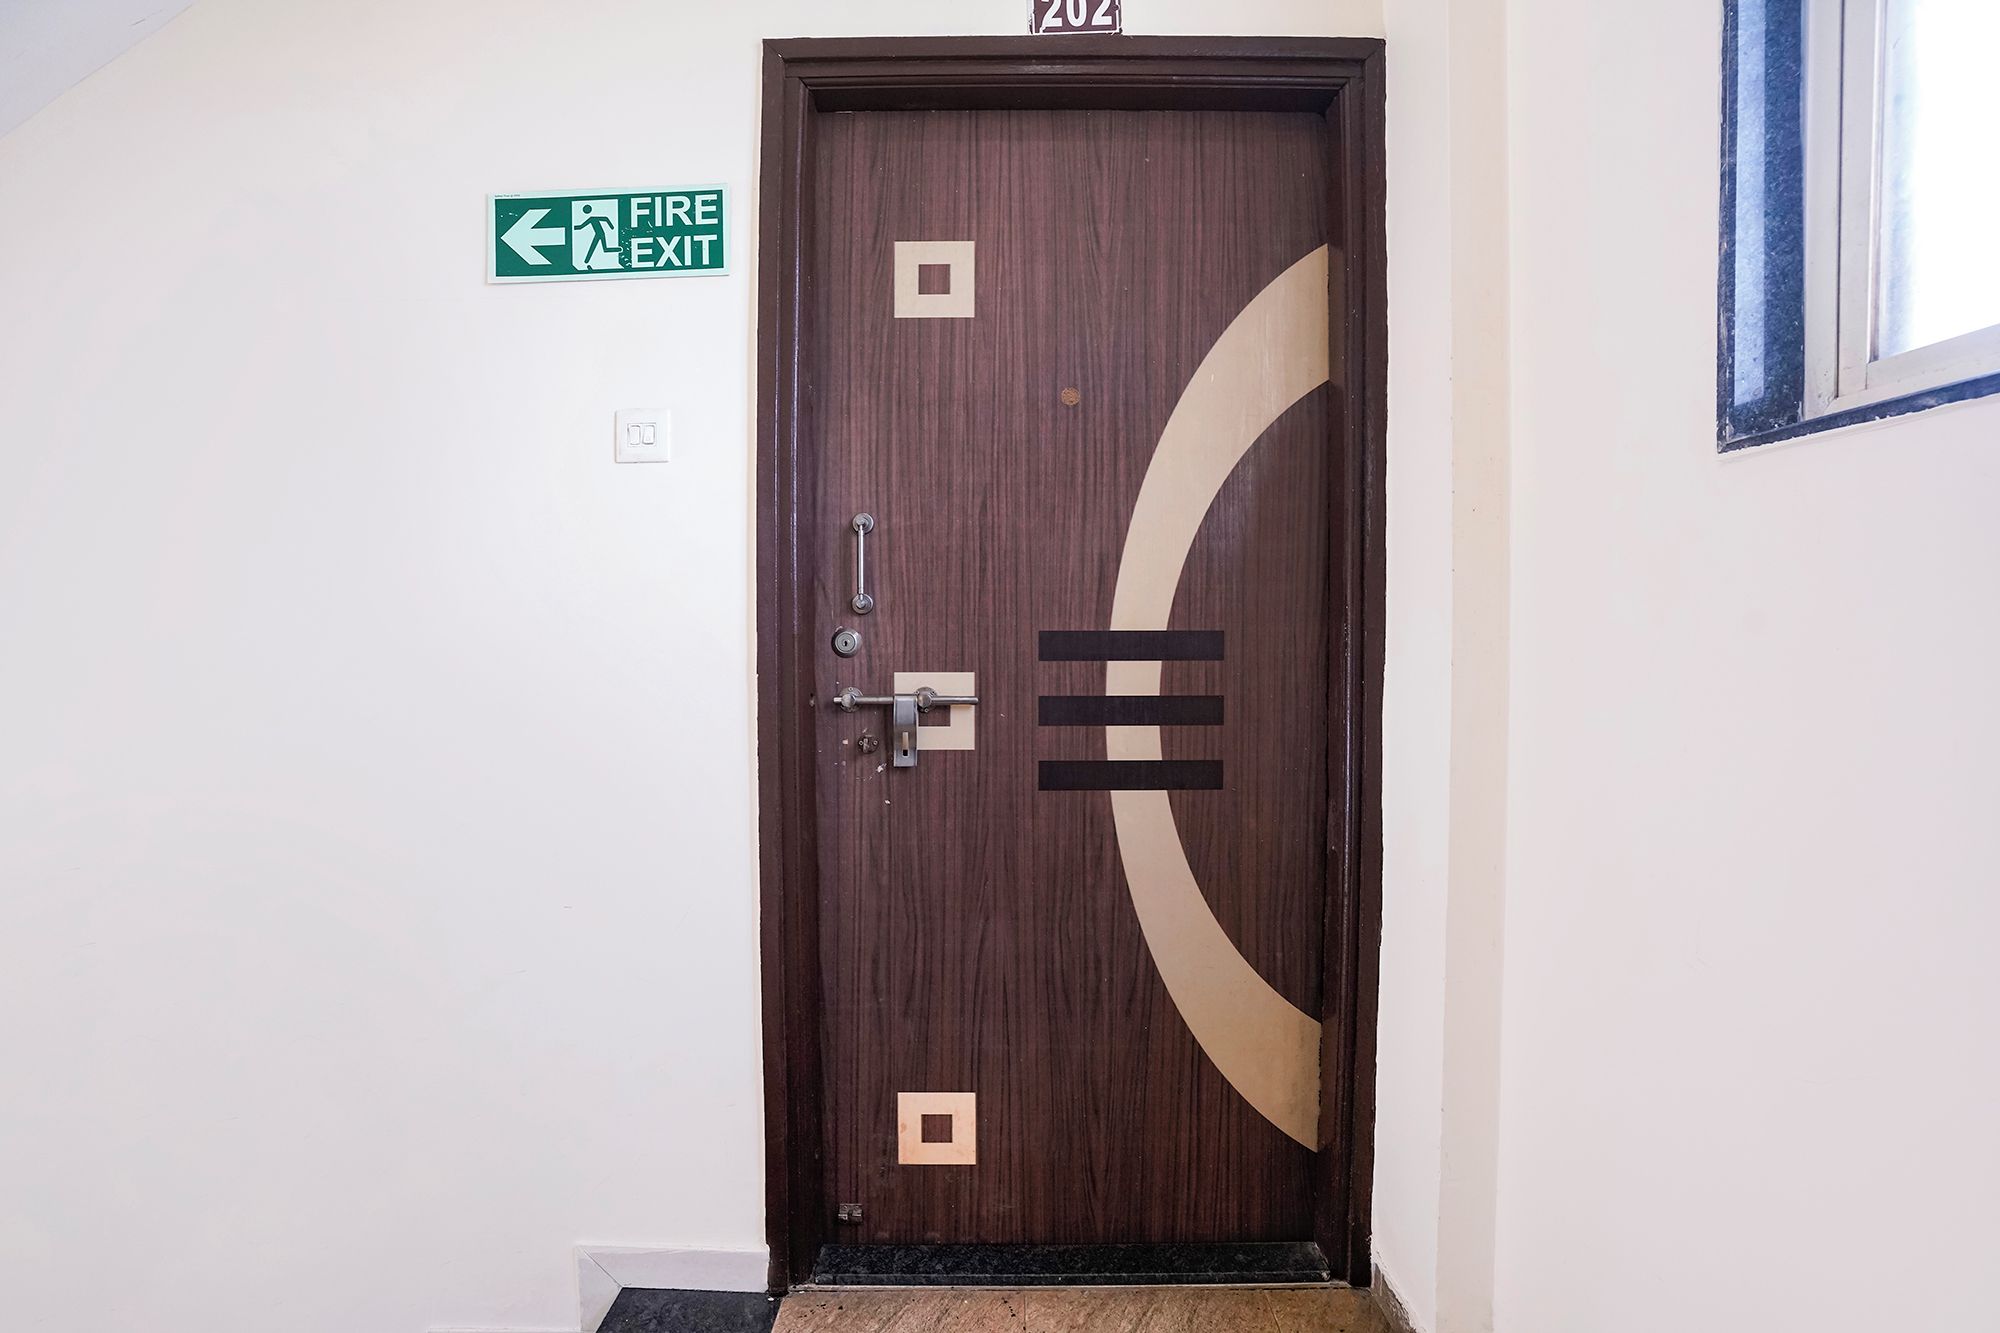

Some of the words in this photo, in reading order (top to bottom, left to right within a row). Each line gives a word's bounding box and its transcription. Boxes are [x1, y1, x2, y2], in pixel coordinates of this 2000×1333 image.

[1041, 0, 1112, 27] 202
[630, 194, 719, 228] FIRE
[631, 234, 718, 268] EXIT
